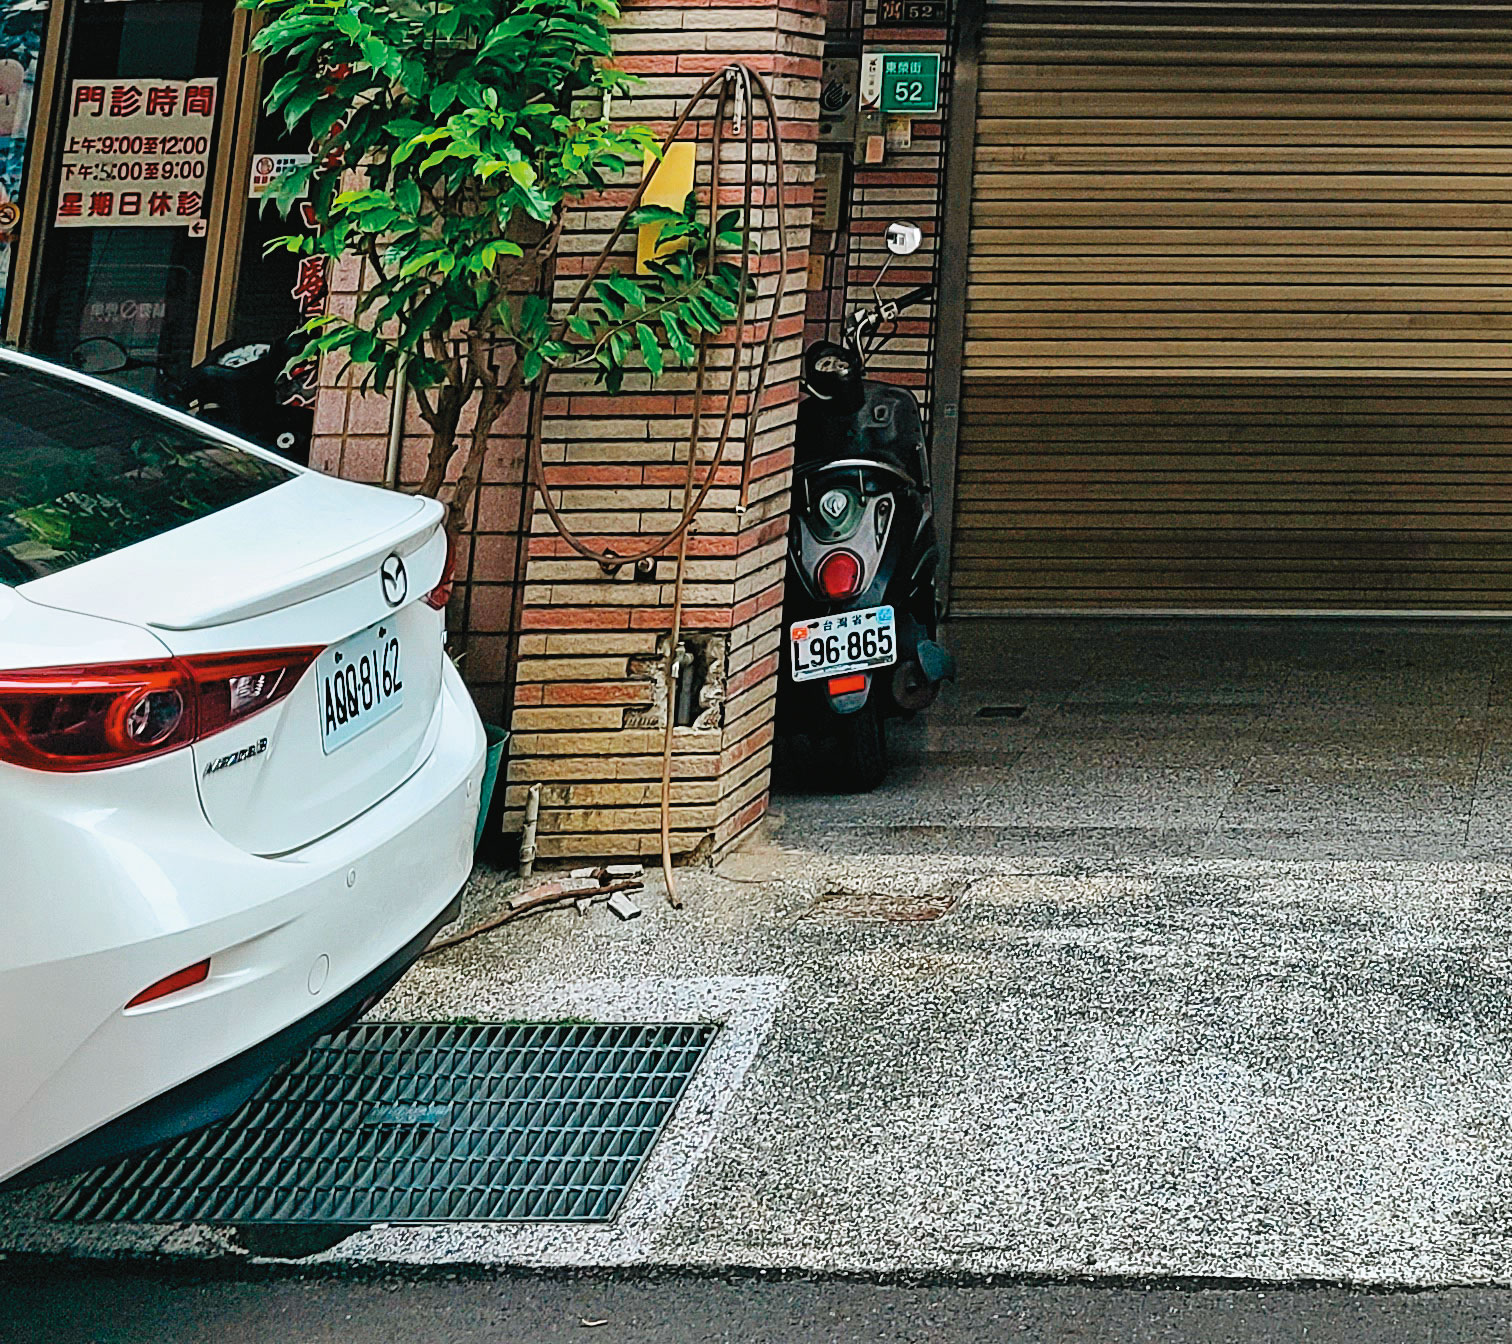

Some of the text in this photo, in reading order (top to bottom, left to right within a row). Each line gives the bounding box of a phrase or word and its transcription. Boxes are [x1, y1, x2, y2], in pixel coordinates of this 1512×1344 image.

[73, 85, 214, 117] 門診時間
[895, 81, 923, 101] 52
[58, 190, 202, 217] 星期日休診
